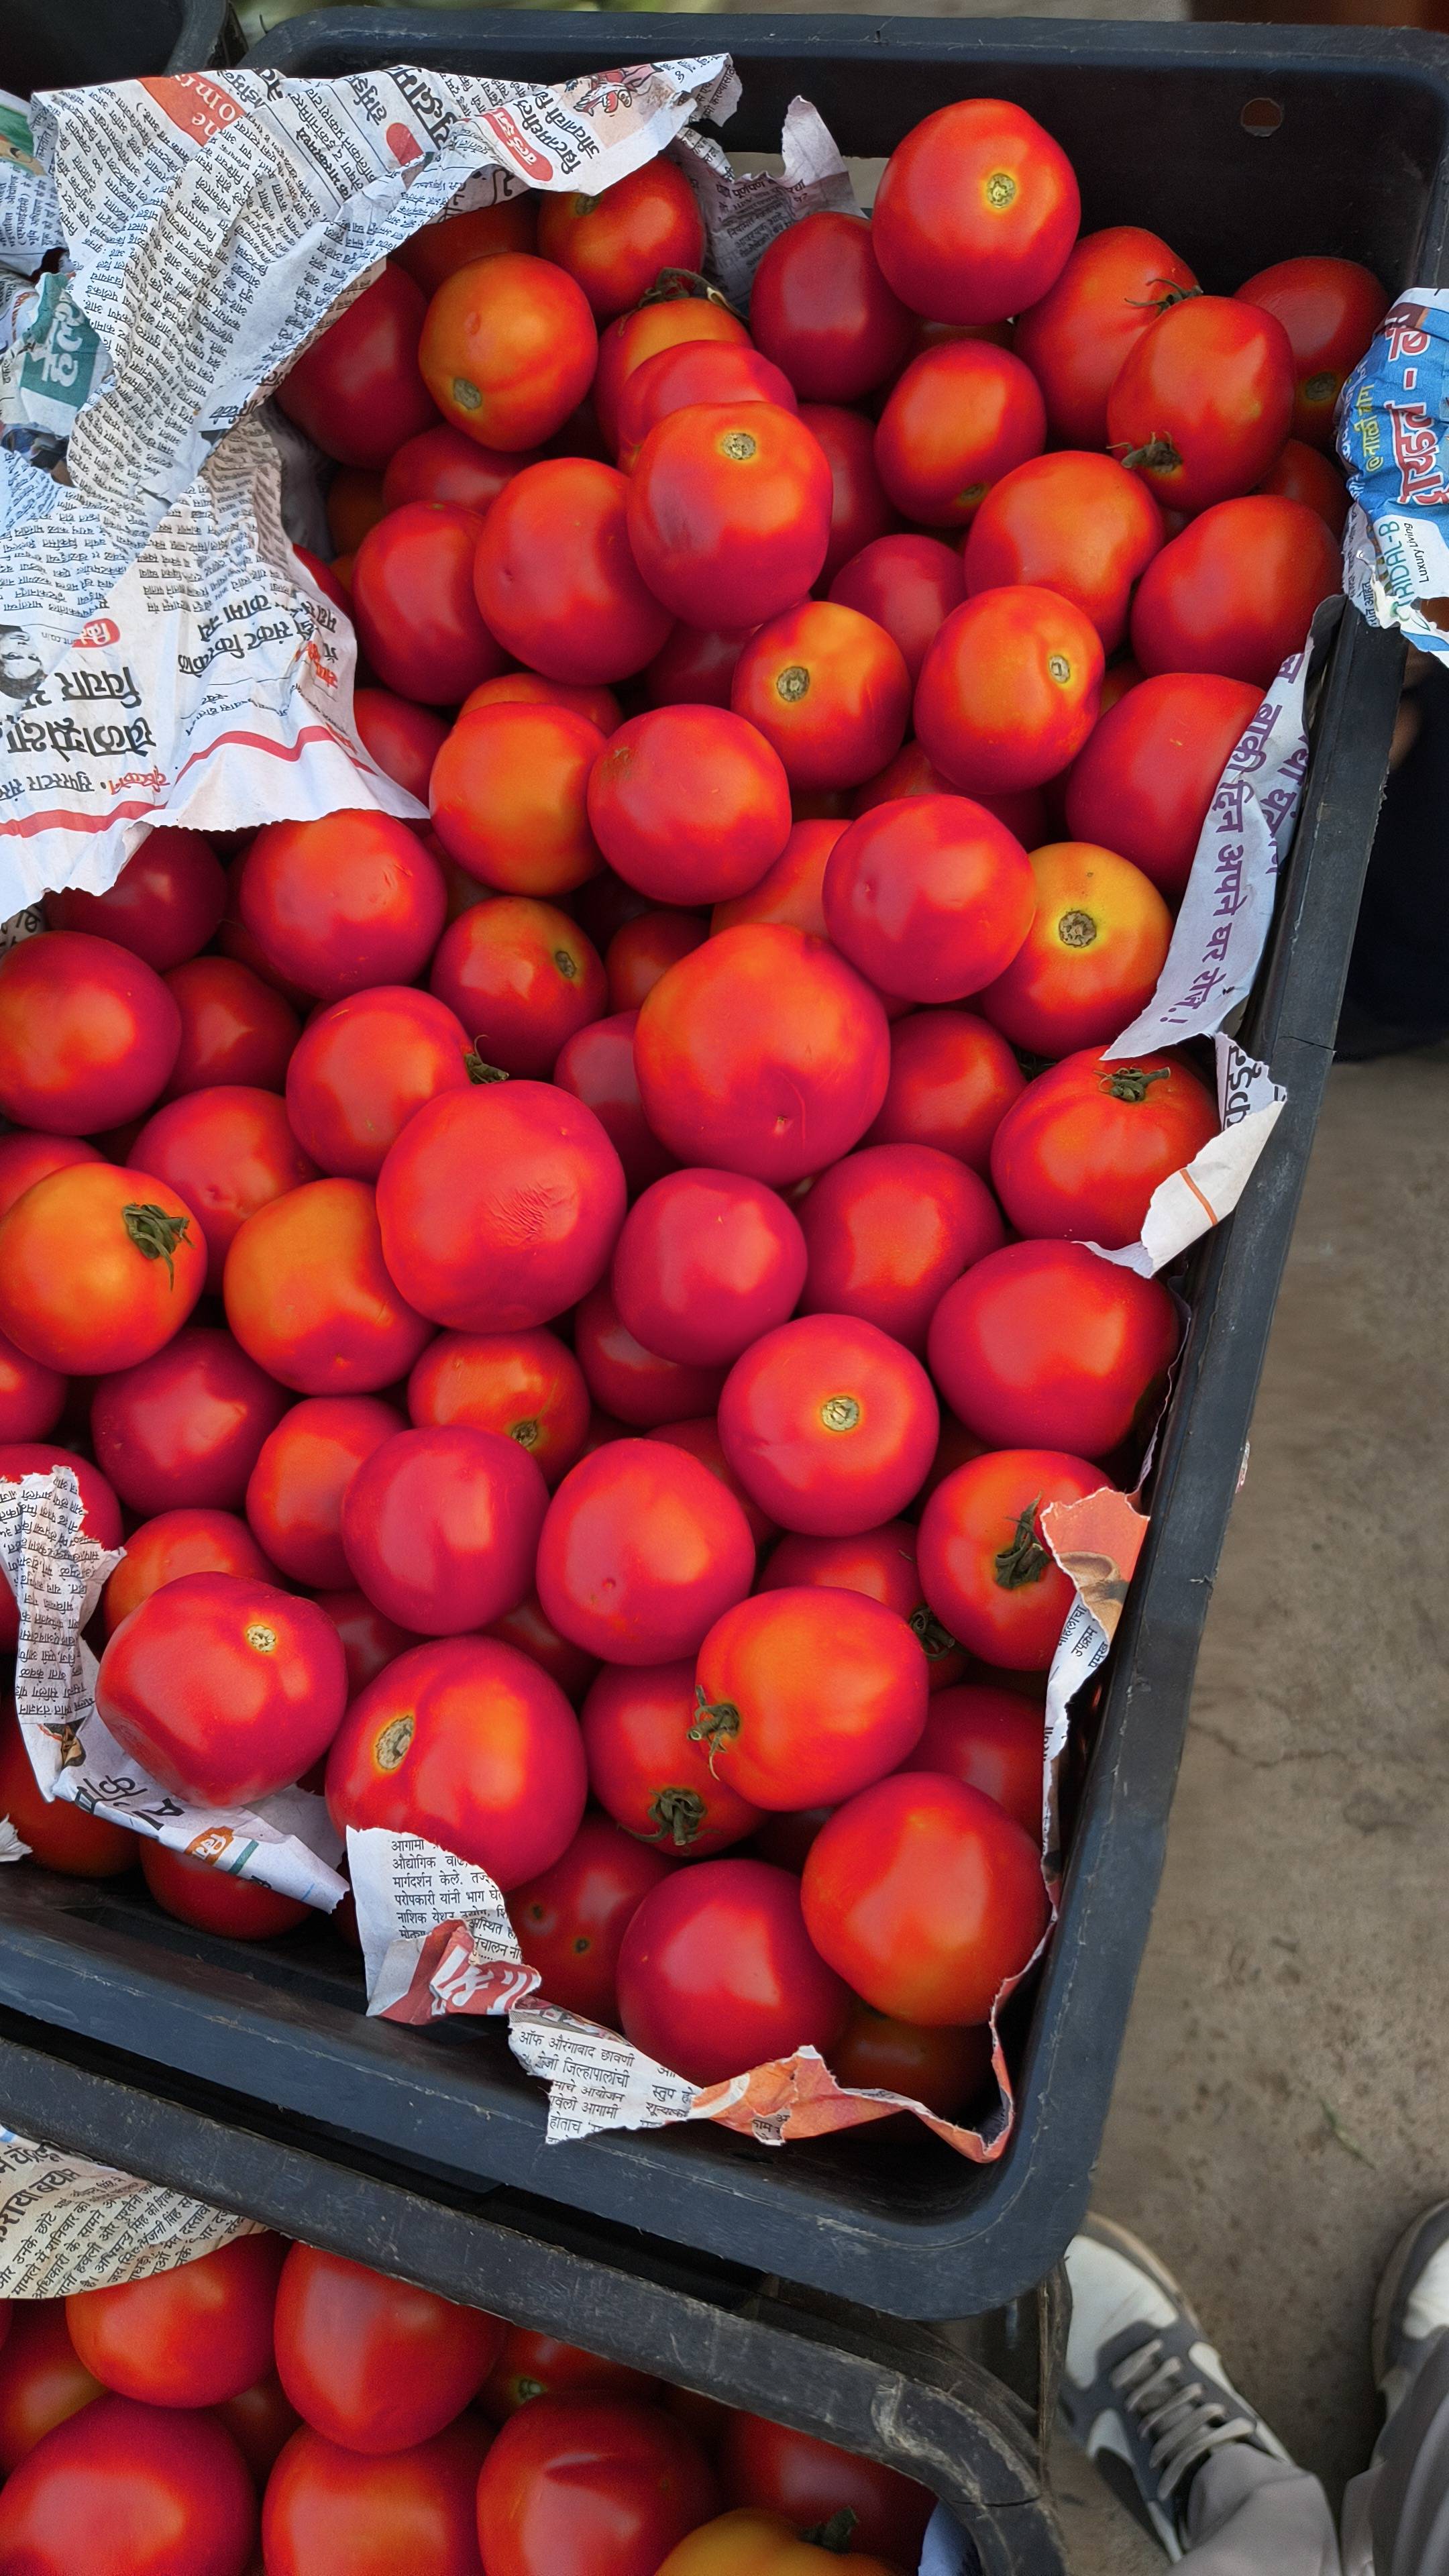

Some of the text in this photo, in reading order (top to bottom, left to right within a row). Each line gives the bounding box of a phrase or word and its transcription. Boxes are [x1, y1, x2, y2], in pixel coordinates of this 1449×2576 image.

[1404, 523, 1429, 583] Luxury Living
[244, 622, 292, 650] संकट
[56, 667, 141, 708] विचार
[1231, 704, 1281, 780] बाकी
[28, 771, 93, 792] सुपरस्टार
[1214, 844, 1244, 916] अपने
[1206, 923, 1232, 962] घर
[1071, 1625, 1097, 1656] उपक्रम
[393, 1854, 435, 1869] औद्योगिक
[392, 1870, 463, 1888] मार्गदर्शन केले.
[394, 1888, 484, 1905] परोपकारी यांनी भाग
[396, 1909, 427, 1923] नाशिक
[520, 2031, 635, 2066] ऑफ औरंगाबाद छावणी
[563, 2061, 629, 2087] जिल्हापालांची
[582, 2087, 625, 2102] आयोजन
[582, 2102, 620, 2118] आगामी
[64, 2239, 80, 2252] के
[78, 2210, 105, 2237] सामने
[126, 2214, 149, 2233] सिंह
[163, 2208, 182, 2226] सिंह
[13, 2236, 38, 2264] उनके
[35, 2211, 56, 2234] छोटे
[12, 2214, 79, 2294] मामले में शनिवार
[74, 2242, 102, 2273] हवेली
